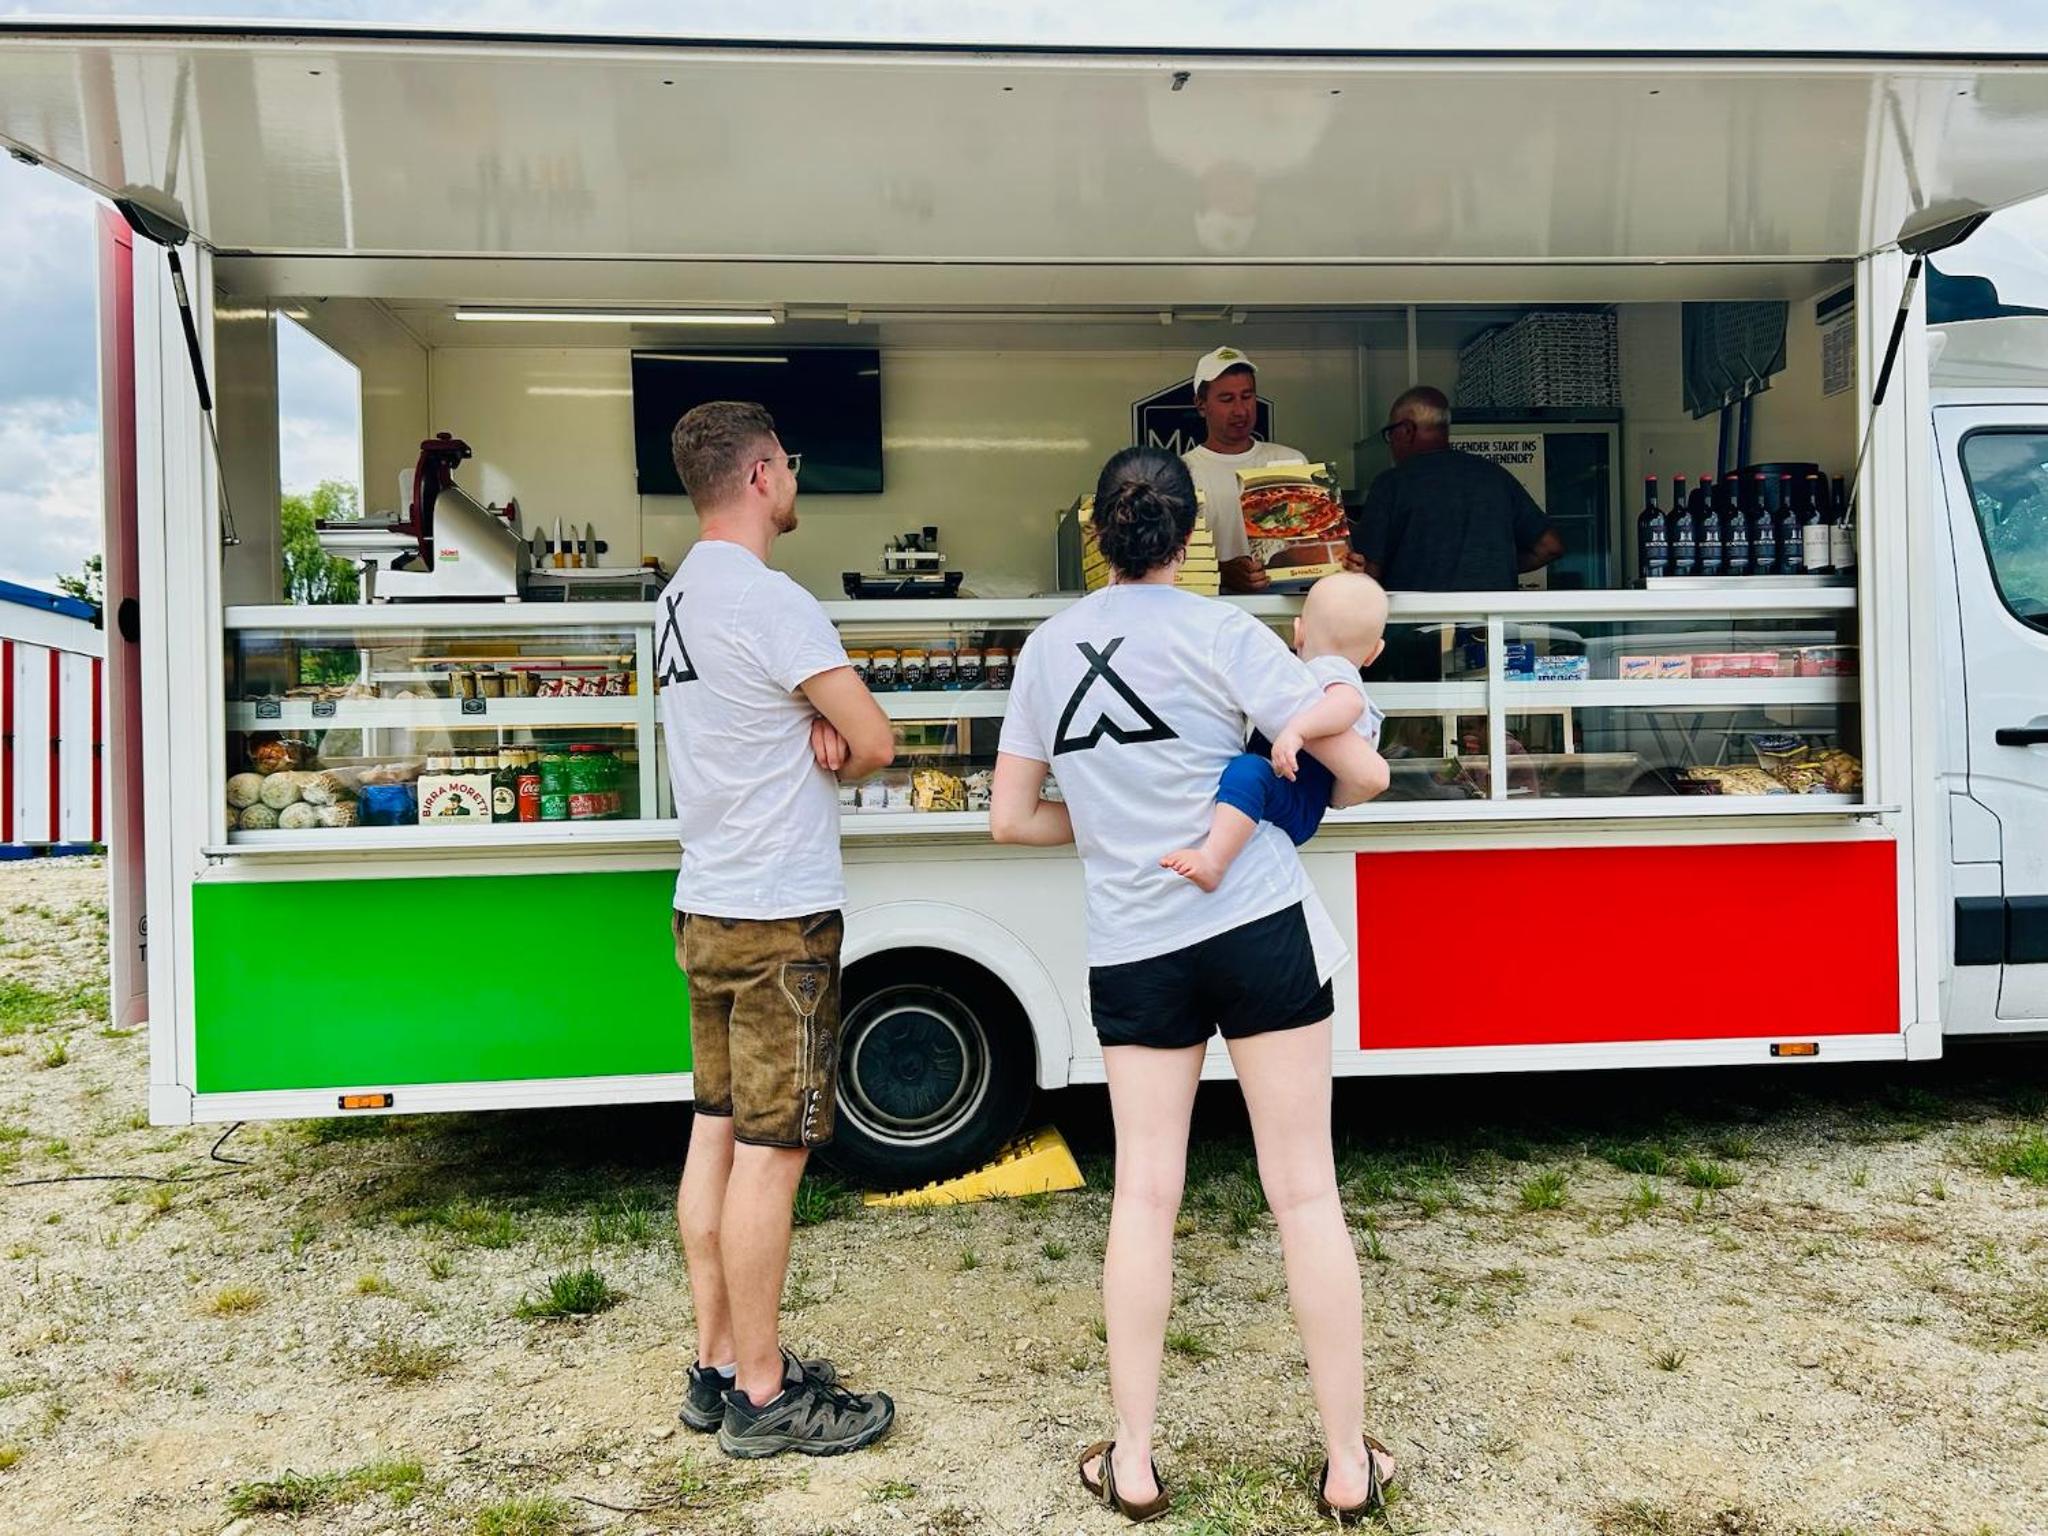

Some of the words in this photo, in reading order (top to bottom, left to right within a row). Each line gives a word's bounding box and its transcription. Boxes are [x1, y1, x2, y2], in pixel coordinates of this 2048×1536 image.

[1449, 441, 1489, 452] EGENDER
[1493, 440, 1518, 452] START
[1522, 440, 1537, 452] INS
[1484, 453, 1534, 464] CHENENDE?
[422, 786, 447, 817] BIRRA
[448, 783, 490, 816] MORETTI
